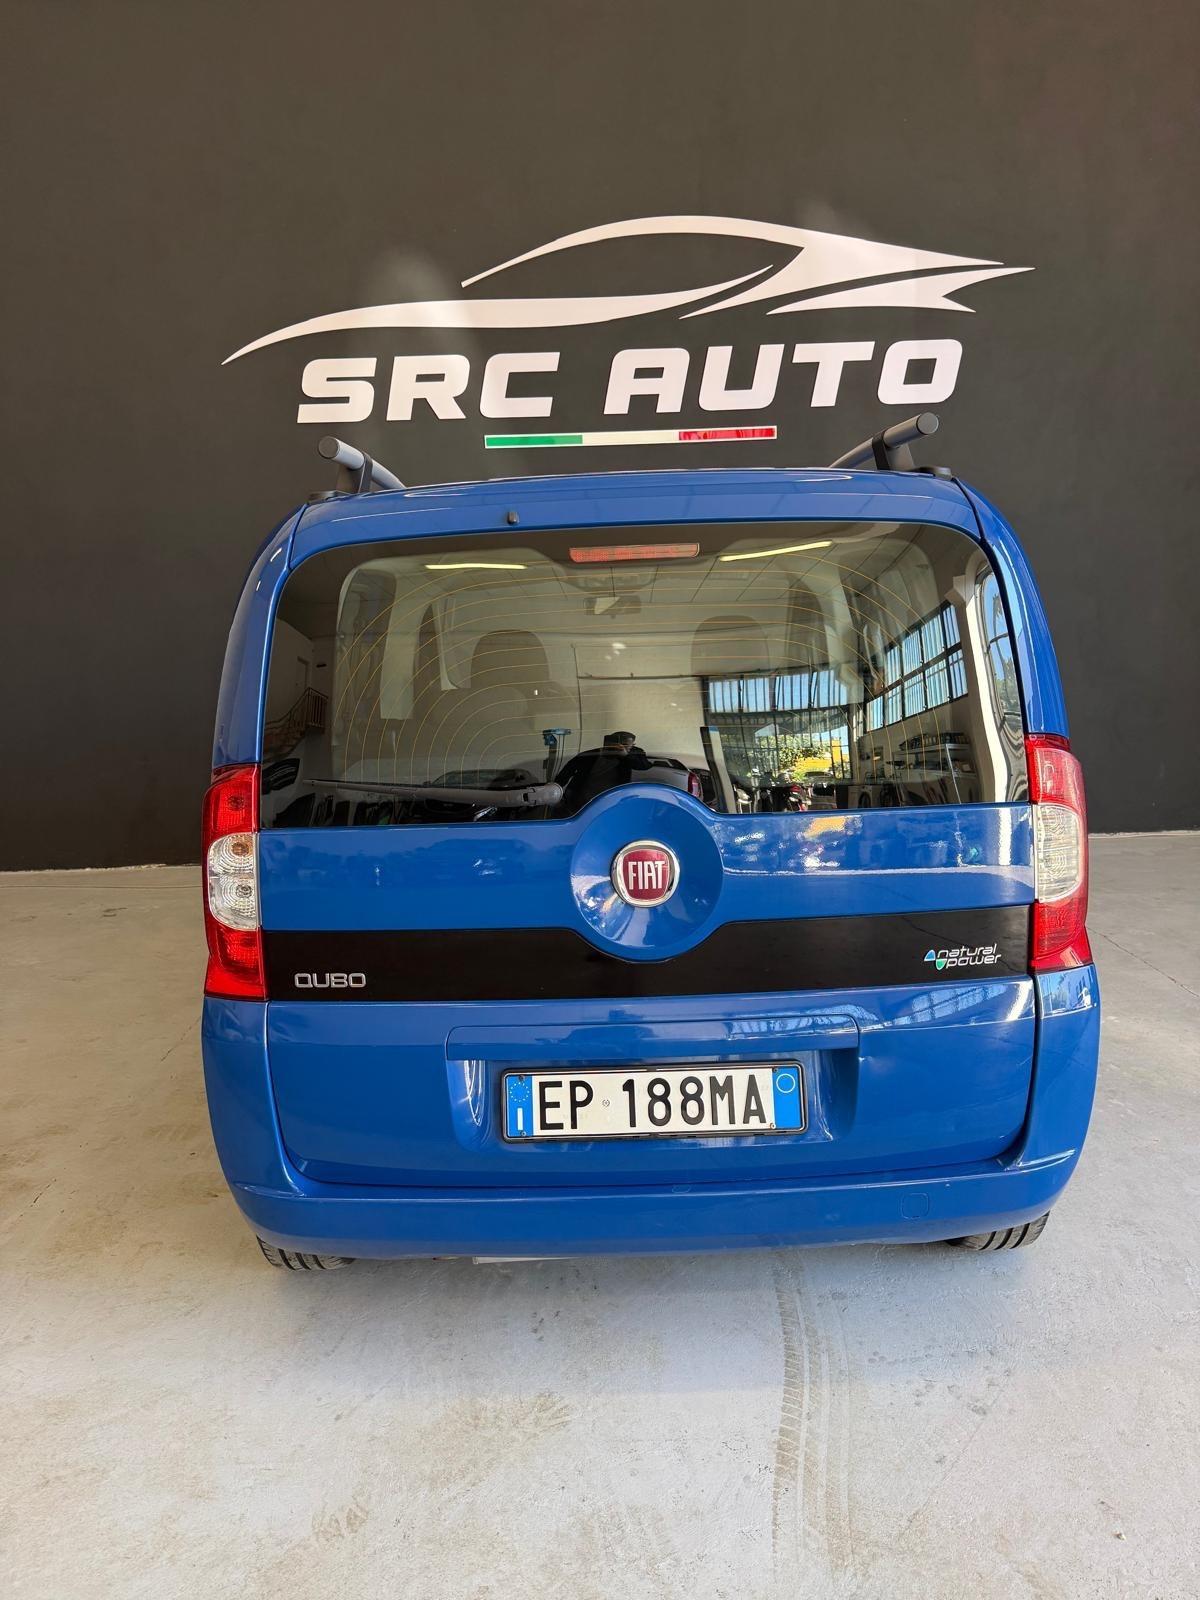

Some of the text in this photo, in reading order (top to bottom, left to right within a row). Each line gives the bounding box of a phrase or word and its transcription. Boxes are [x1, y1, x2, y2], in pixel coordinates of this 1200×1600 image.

[297, 339, 963, 423] SRC AUTO
[628, 861, 666, 890] FIAT
[937, 943, 997, 958] natural
[945, 954, 1001, 969] power
[294, 973, 367, 988] QUBO
[538, 1074, 767, 1130] EP 188MA
